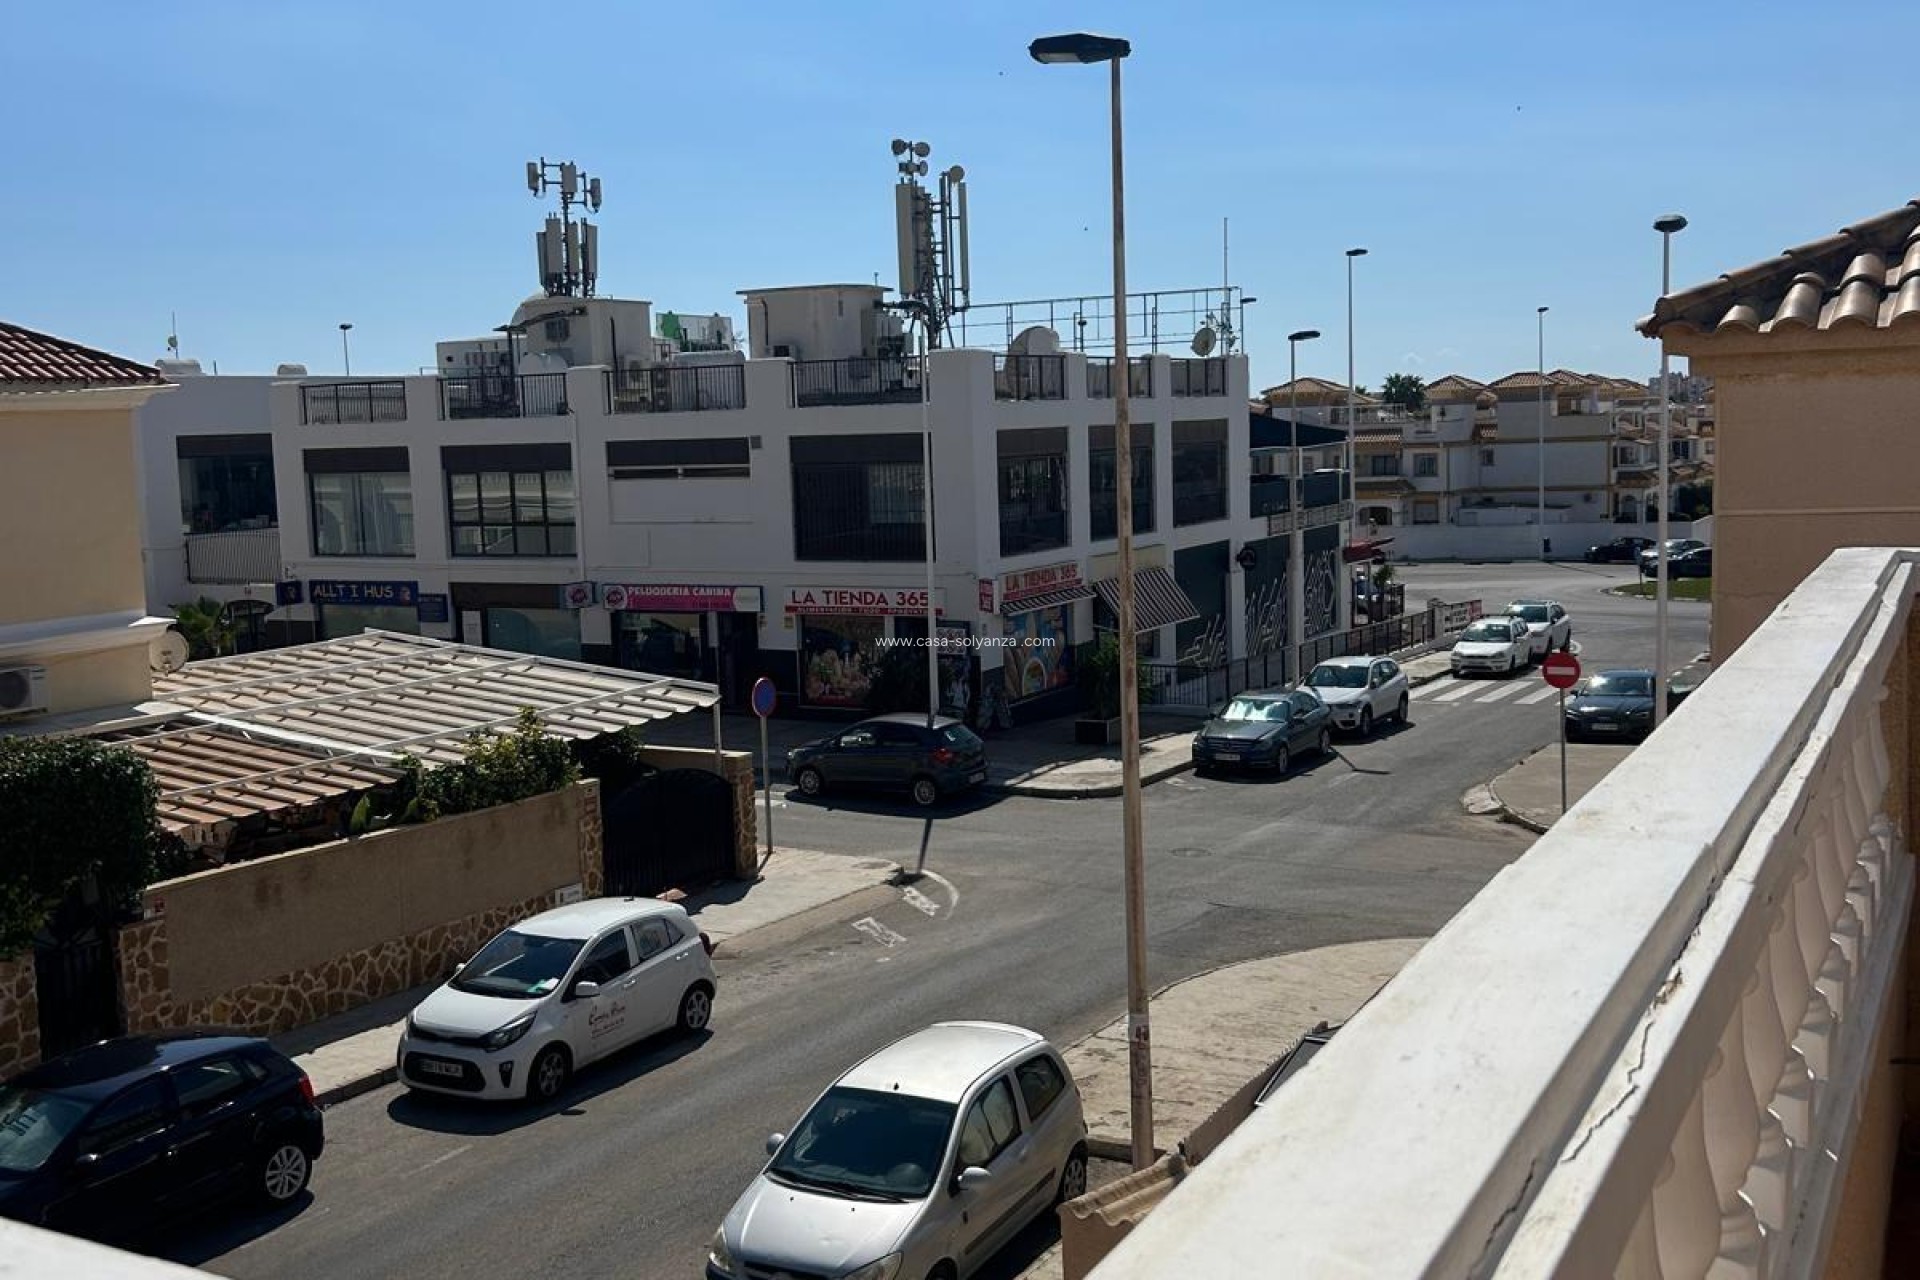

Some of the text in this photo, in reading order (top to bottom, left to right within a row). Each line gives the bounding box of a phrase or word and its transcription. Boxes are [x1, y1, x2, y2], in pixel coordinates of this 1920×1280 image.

[313, 583, 394, 598] ALLT I HUS
[792, 590, 929, 607] LA TIENDA 365
